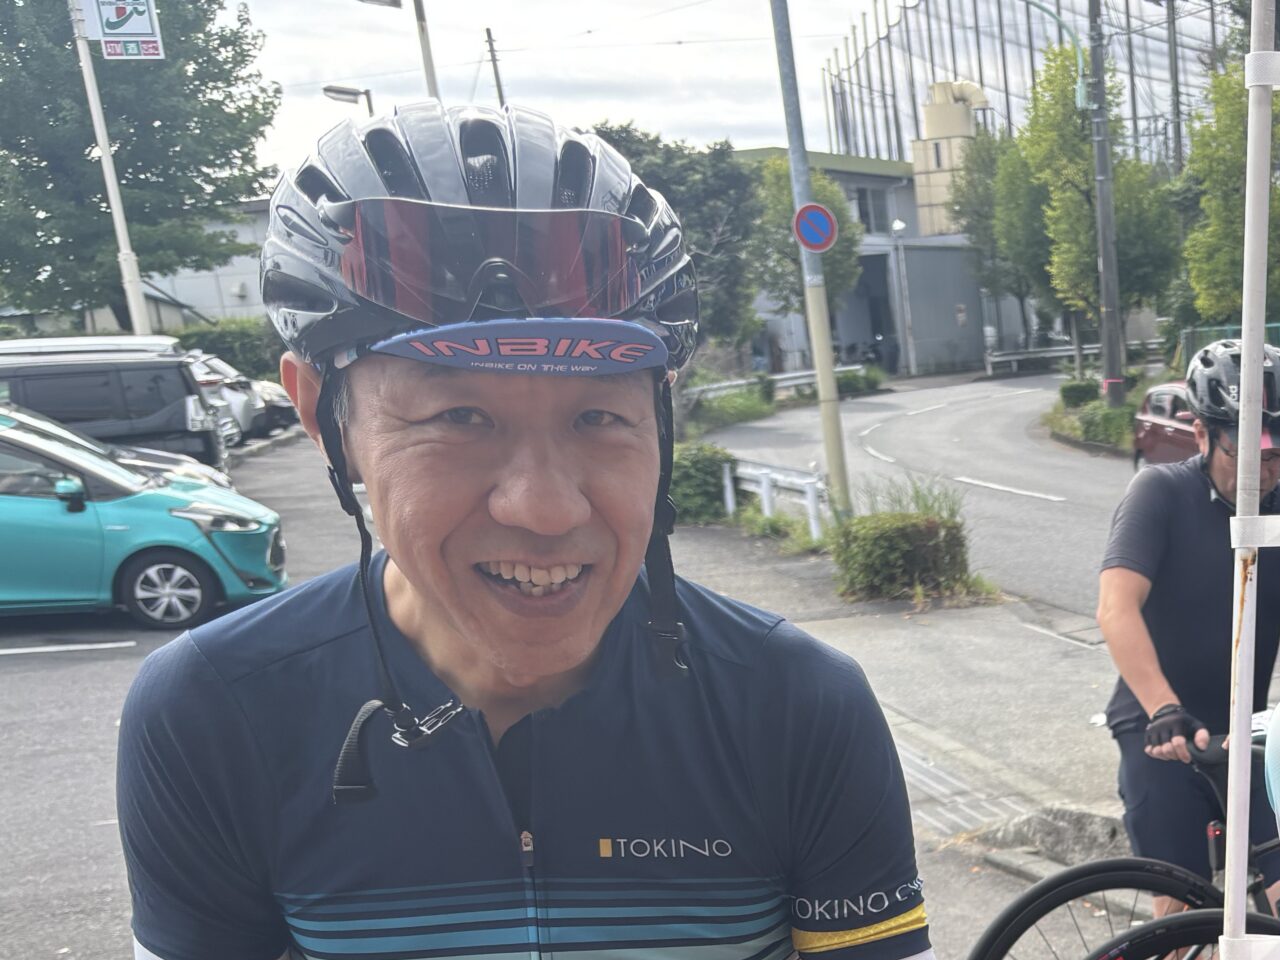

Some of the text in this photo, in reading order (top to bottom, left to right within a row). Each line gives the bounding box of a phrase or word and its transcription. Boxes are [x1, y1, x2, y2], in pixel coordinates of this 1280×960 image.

[408, 338, 655, 363] INBIKE
[471, 361, 513, 370] INBIKE
[517, 363, 537, 371] ON
[541, 363, 568, 372] THE
[616, 838, 732, 858] TOKINO
[791, 891, 890, 921] OKINO
